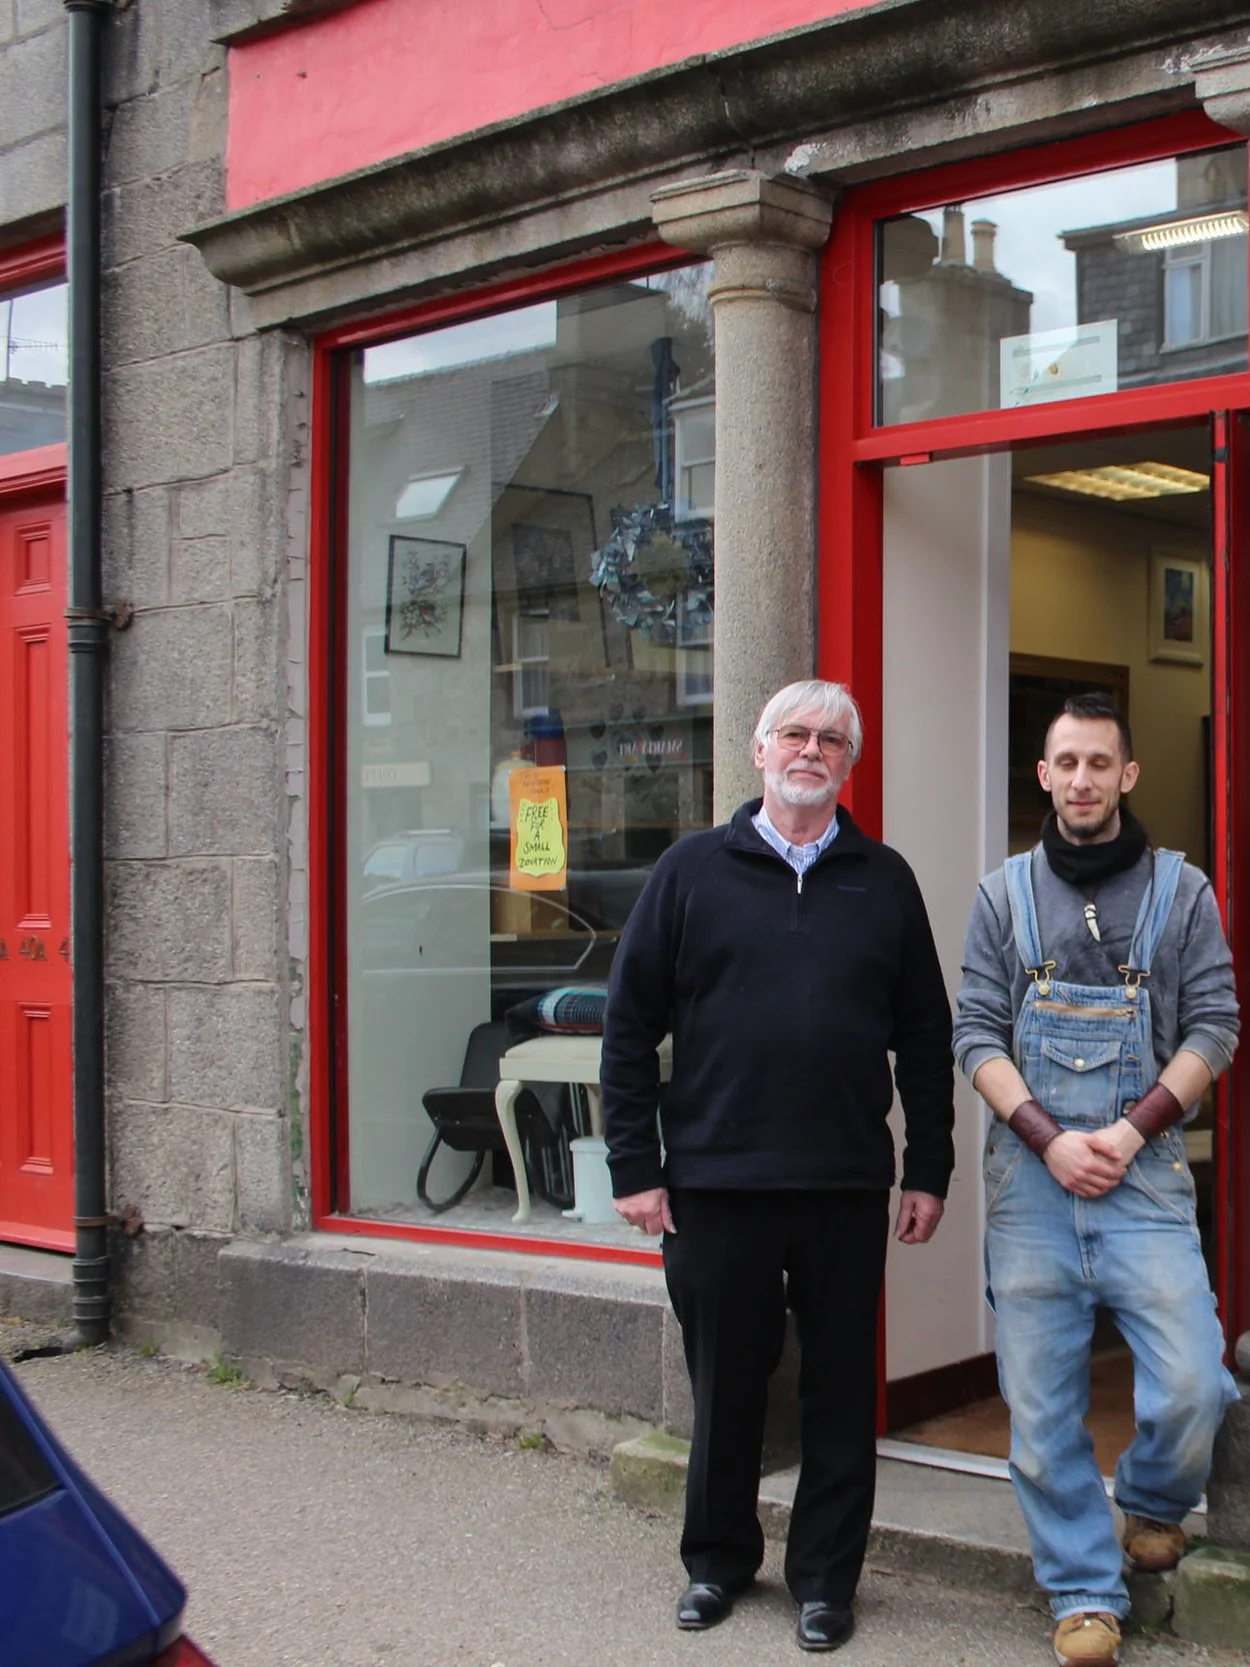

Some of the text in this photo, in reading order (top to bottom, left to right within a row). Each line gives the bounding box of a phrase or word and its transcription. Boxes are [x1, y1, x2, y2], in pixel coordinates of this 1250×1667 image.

[525, 806, 549, 822] FREE
[533, 830, 541, 841] A
[523, 841, 551, 854] SMALL
[519, 856, 558, 868] DONATION
